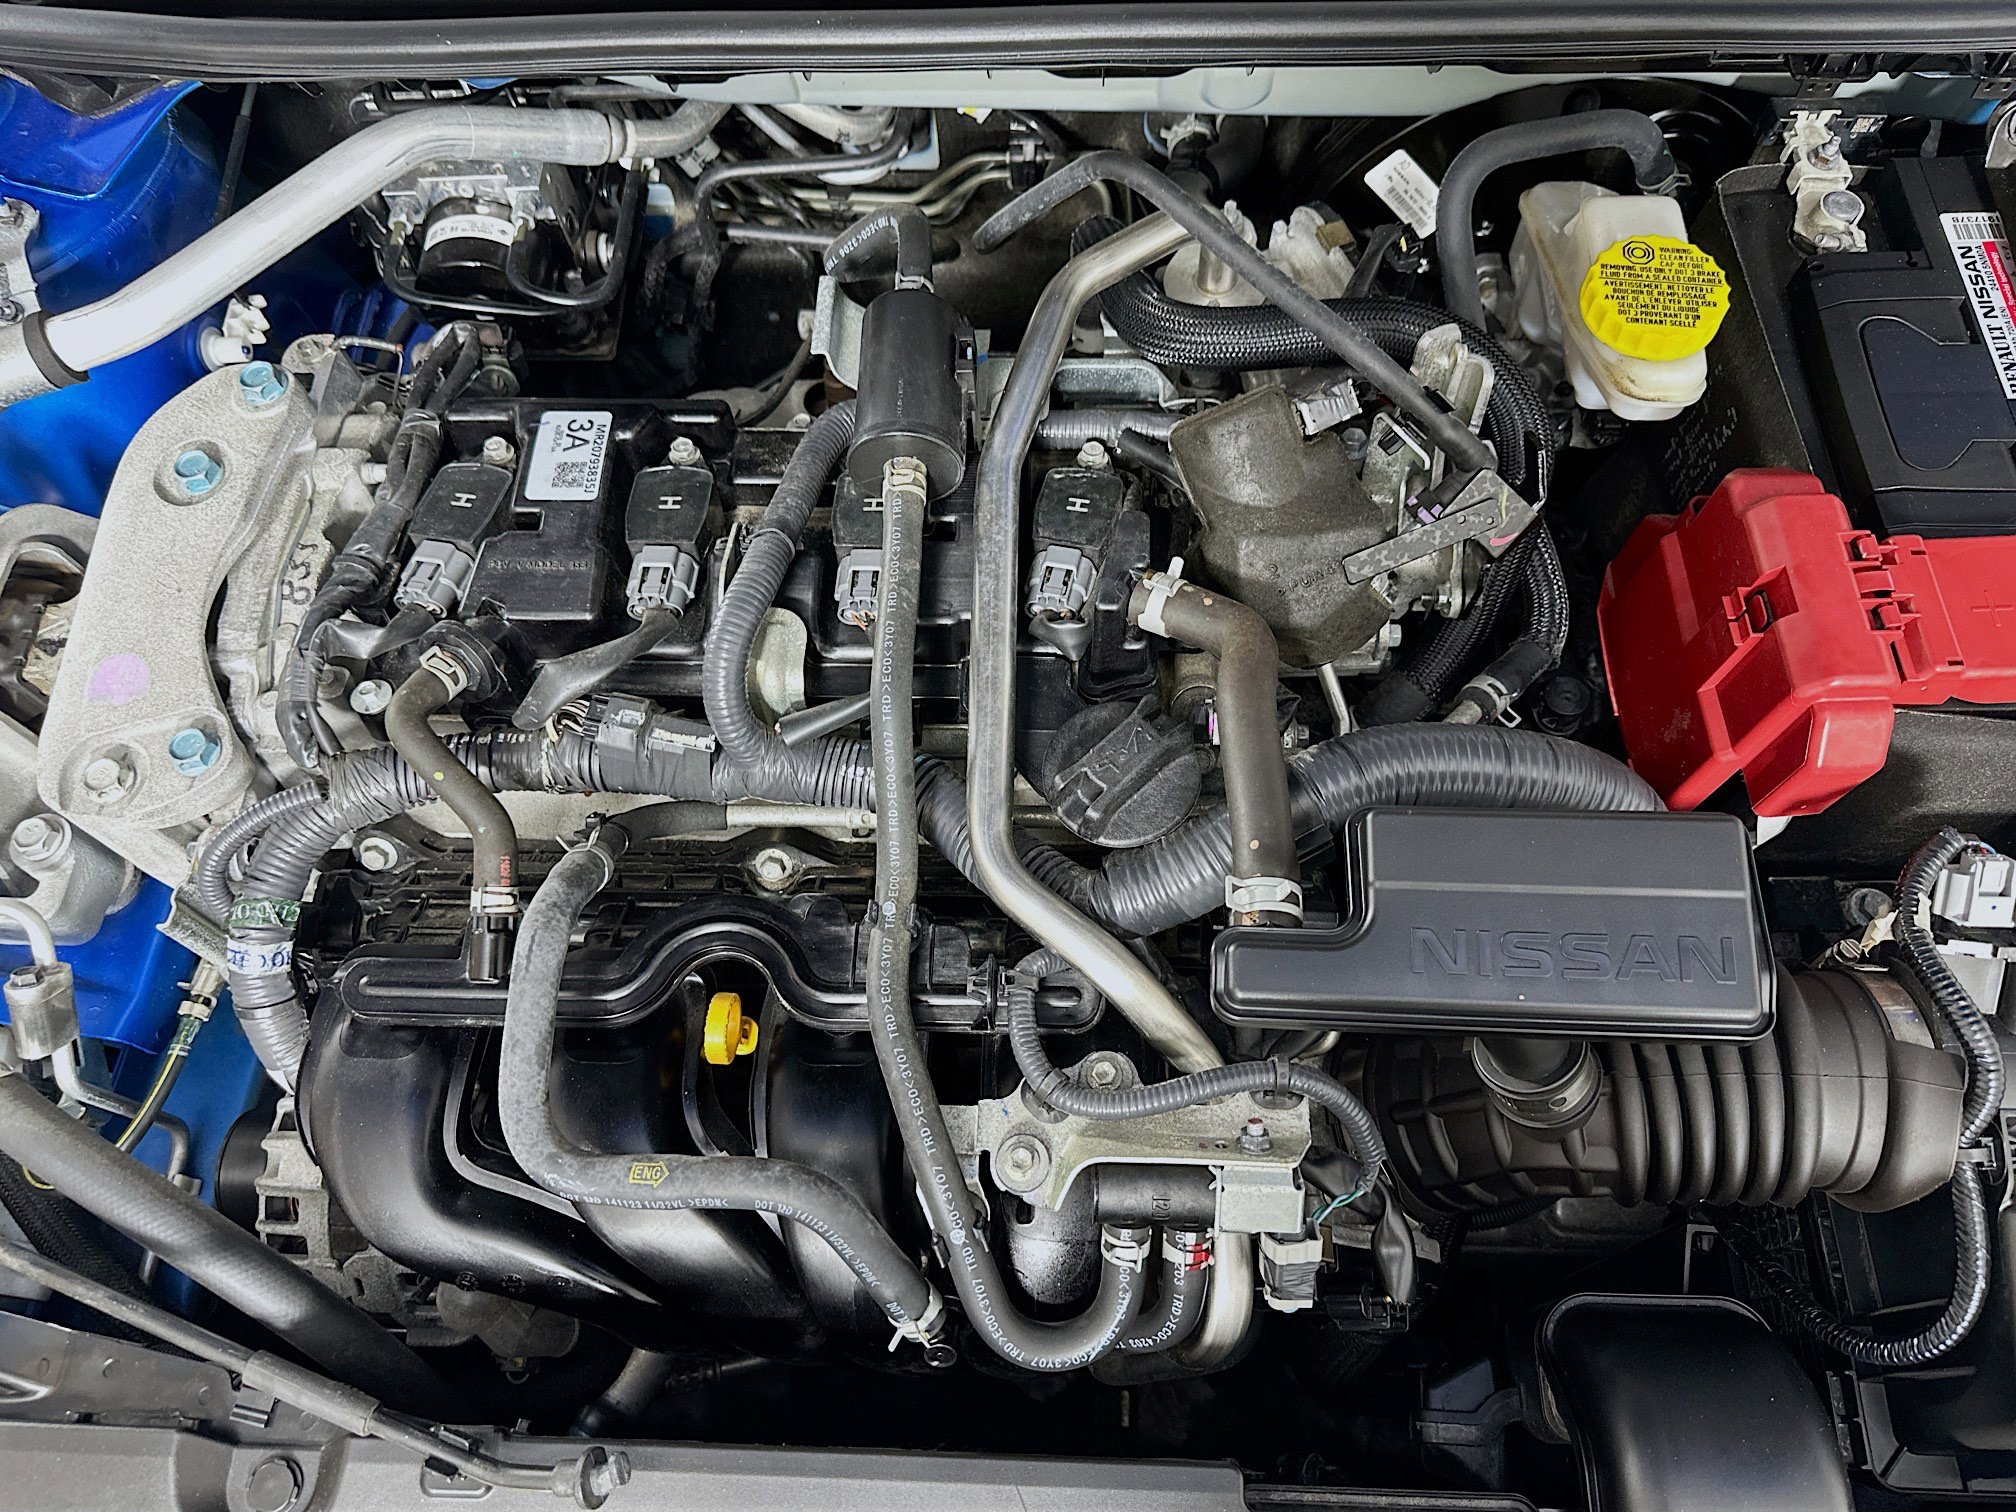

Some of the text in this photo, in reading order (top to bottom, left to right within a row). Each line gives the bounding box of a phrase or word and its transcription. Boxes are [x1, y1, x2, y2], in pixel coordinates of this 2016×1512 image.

[1683, 275, 1722, 285] CONTAINER
[1957, 246, 1999, 318] NISSAN
[1612, 287, 1644, 296] BOUCHON
[1657, 291, 1707, 300] REMPLISSAGE
[1667, 285, 1704, 293] NETTOYER
[1617, 302, 1660, 310] SEULEMENT
[1685, 299, 1718, 308] UTILISER
[1626, 316, 1668, 326] CONTENANT
[1640, 311, 1682, 319] PROVENANT
[562, 419, 594, 453] 3A
[584, 424, 607, 493] MR20793835J
[1410, 927, 1737, 984] NISSAN
[633, 1167, 663, 1180] ENG
[1152, 1194, 1171, 1221] 120
[755, 1199, 773, 1210] DOT
[795, 1209, 829, 1233] 141123
